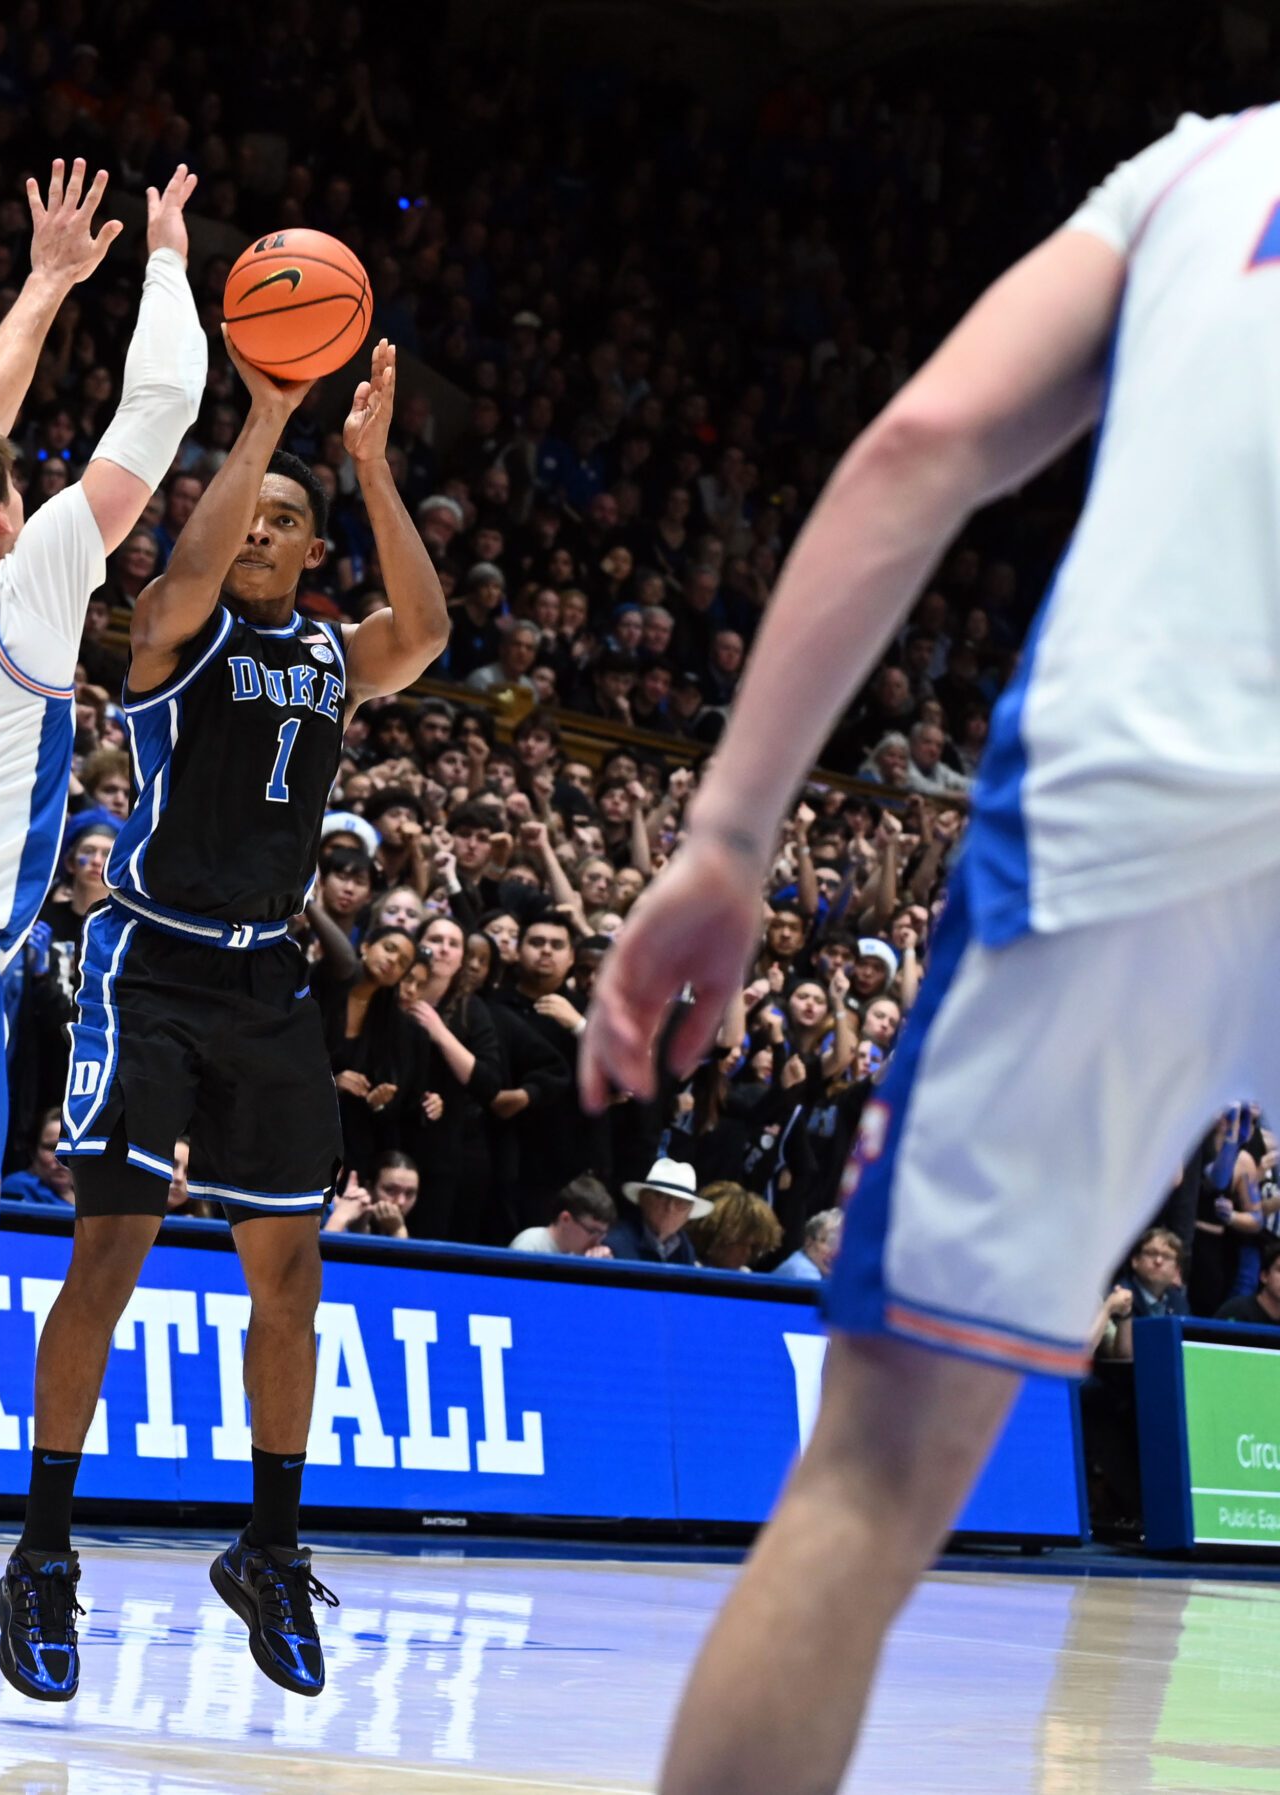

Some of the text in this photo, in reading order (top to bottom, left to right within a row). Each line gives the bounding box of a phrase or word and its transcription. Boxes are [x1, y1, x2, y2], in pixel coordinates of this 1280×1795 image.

[227, 656, 345, 723] DUKE
[266, 717, 301, 803] 1
[71, 1060, 101, 1096] D
[1218, 1506, 1257, 1529] Public
